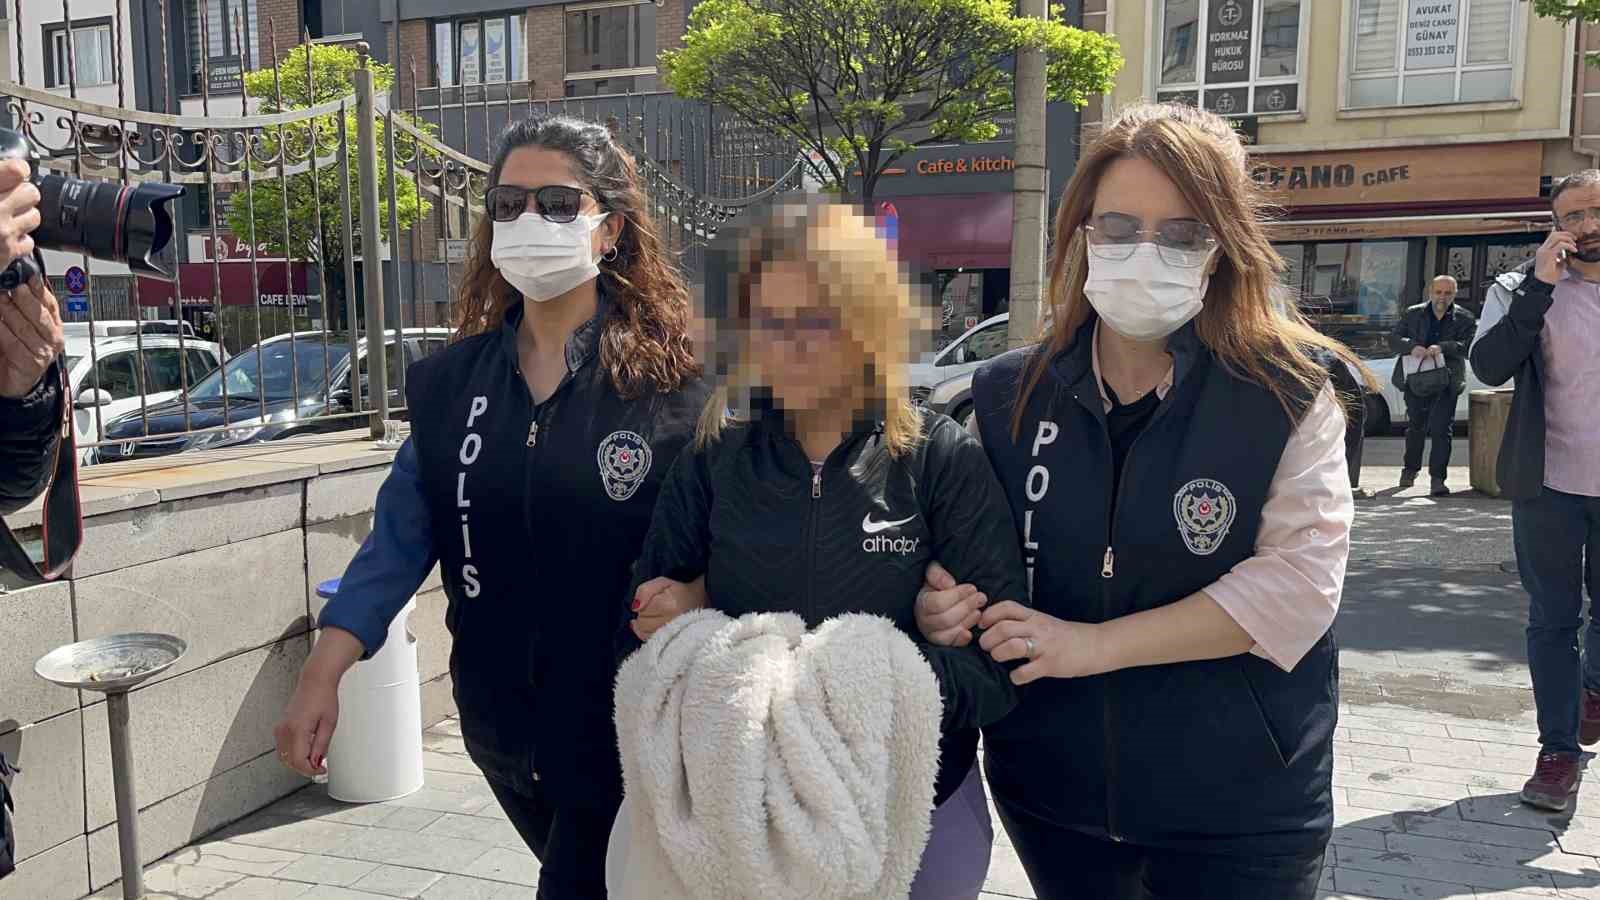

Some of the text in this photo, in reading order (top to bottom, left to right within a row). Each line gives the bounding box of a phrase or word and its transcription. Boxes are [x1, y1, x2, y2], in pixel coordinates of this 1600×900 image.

[1416, 4, 1452, 15] AVUKAT
[1432, 18, 1456, 27] CANSU
[1209, 30, 1249, 42] KORKMAZ
[1416, 30, 1448, 41] GÜNAY
[1215, 46, 1242, 57] HUKUK
[1212, 60, 1244, 72] BÜROSU
[917, 159, 954, 175] Cafe
[955, 158, 967, 173] &
[1362, 165, 1409, 186] CAFE
[260, 294, 284, 305] CAFE
